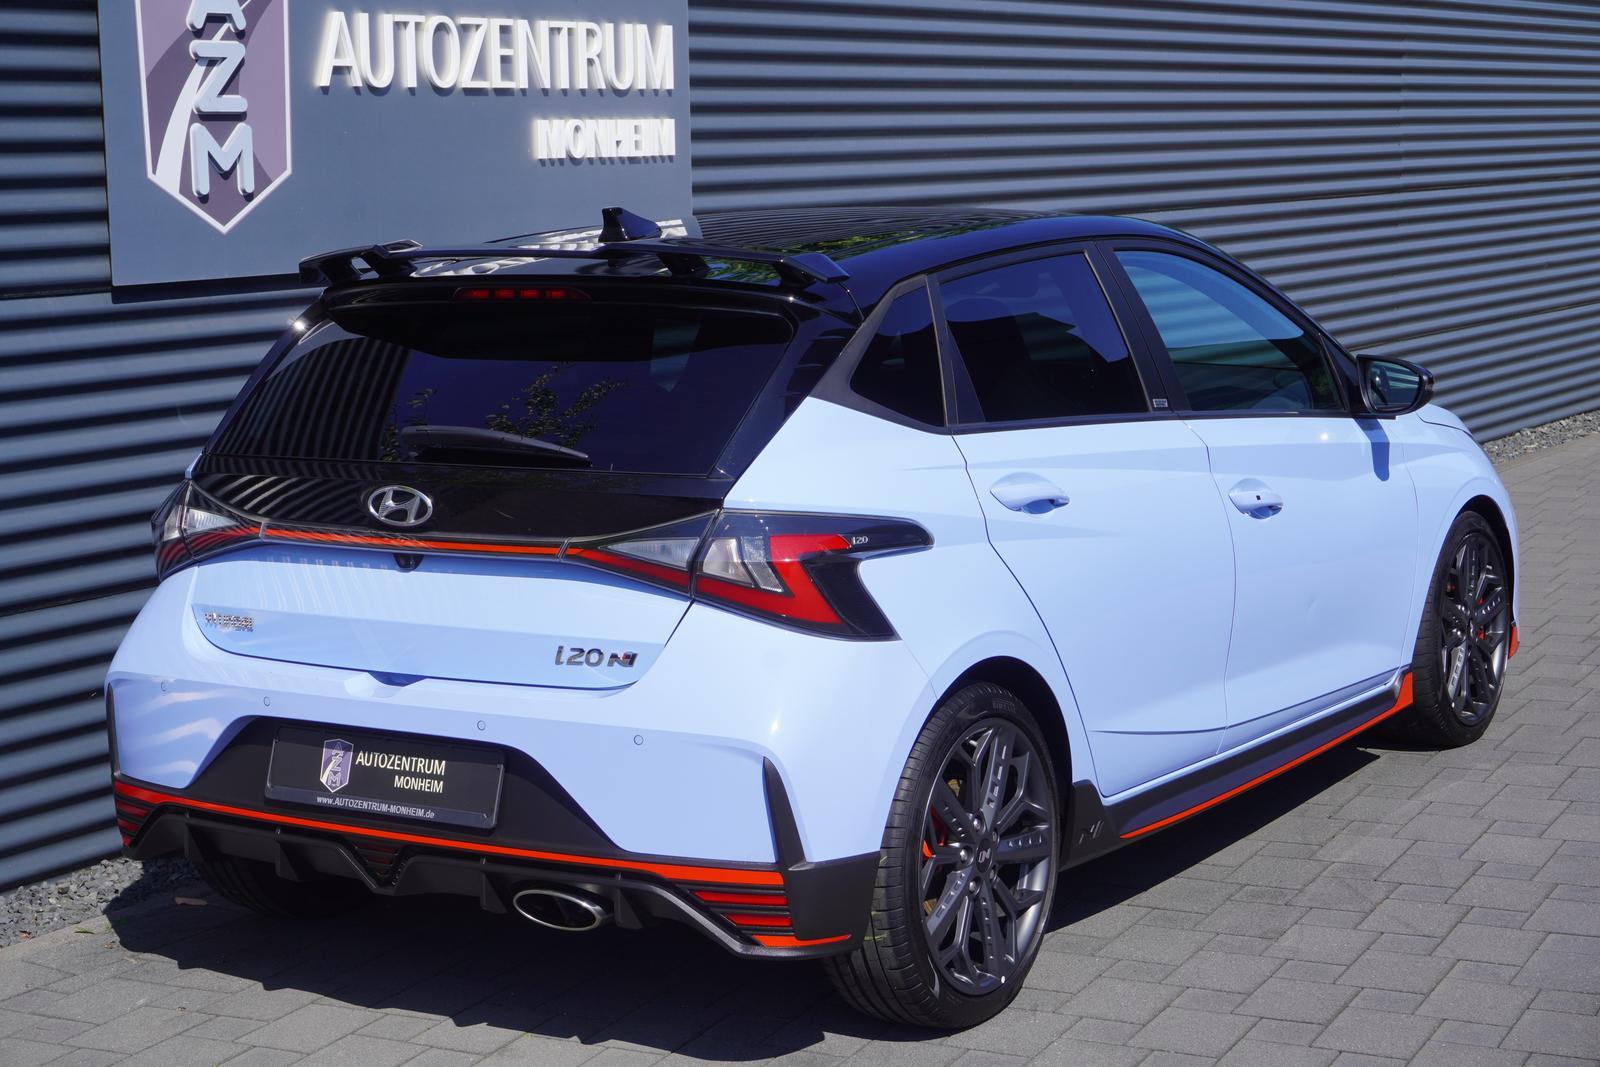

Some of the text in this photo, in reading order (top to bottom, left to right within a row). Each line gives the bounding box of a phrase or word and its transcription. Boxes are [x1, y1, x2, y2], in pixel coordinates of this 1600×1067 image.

[316, 10, 675, 91] AUTOZENTRUM
[534, 118, 676, 160] MONHEIM
[554, 645, 605, 668] i20
[355, 750, 446, 776] AUTOZENTRUM
[394, 775, 444, 794] MONHEIM
[316, 797, 435, 819] www.AUTOZENTRUM-MONHEIM.de
